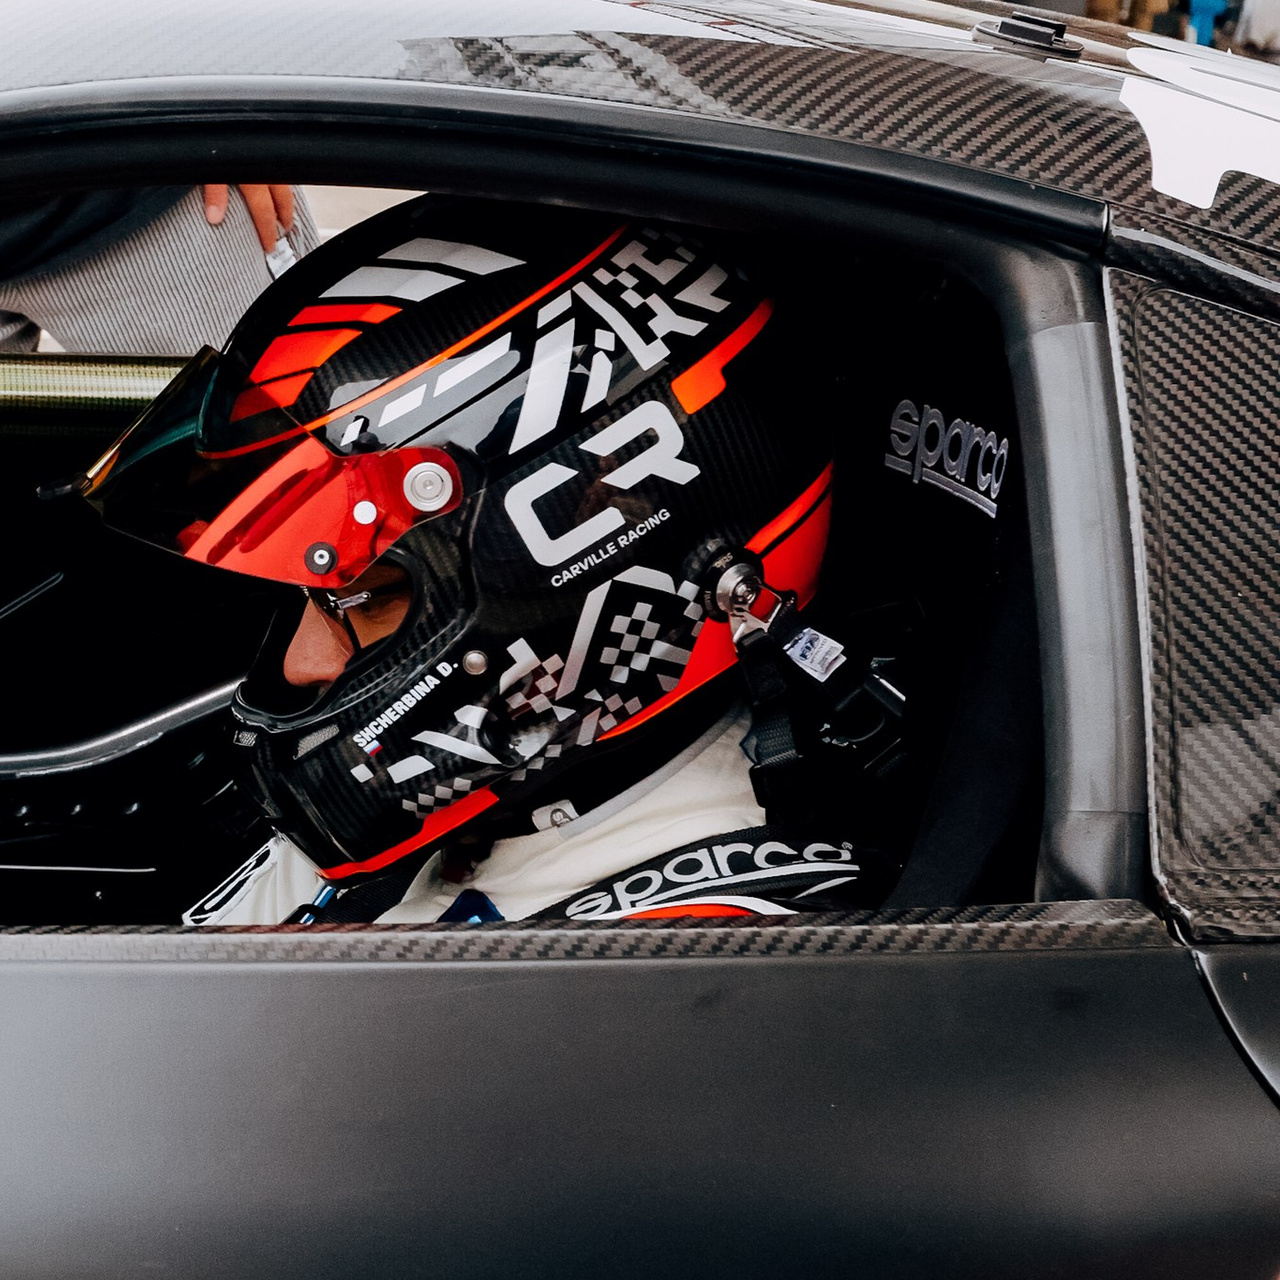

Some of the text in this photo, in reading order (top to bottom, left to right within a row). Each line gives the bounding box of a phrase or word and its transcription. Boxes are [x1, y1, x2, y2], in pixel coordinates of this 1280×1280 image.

[504, 399, 701, 567] CR
[890, 399, 1009, 500] sparco
[550, 508, 671, 588] CARVILLE RACING
[352, 661, 459, 748] SHCHERBINA D.
[565, 841, 853, 919] sparco
